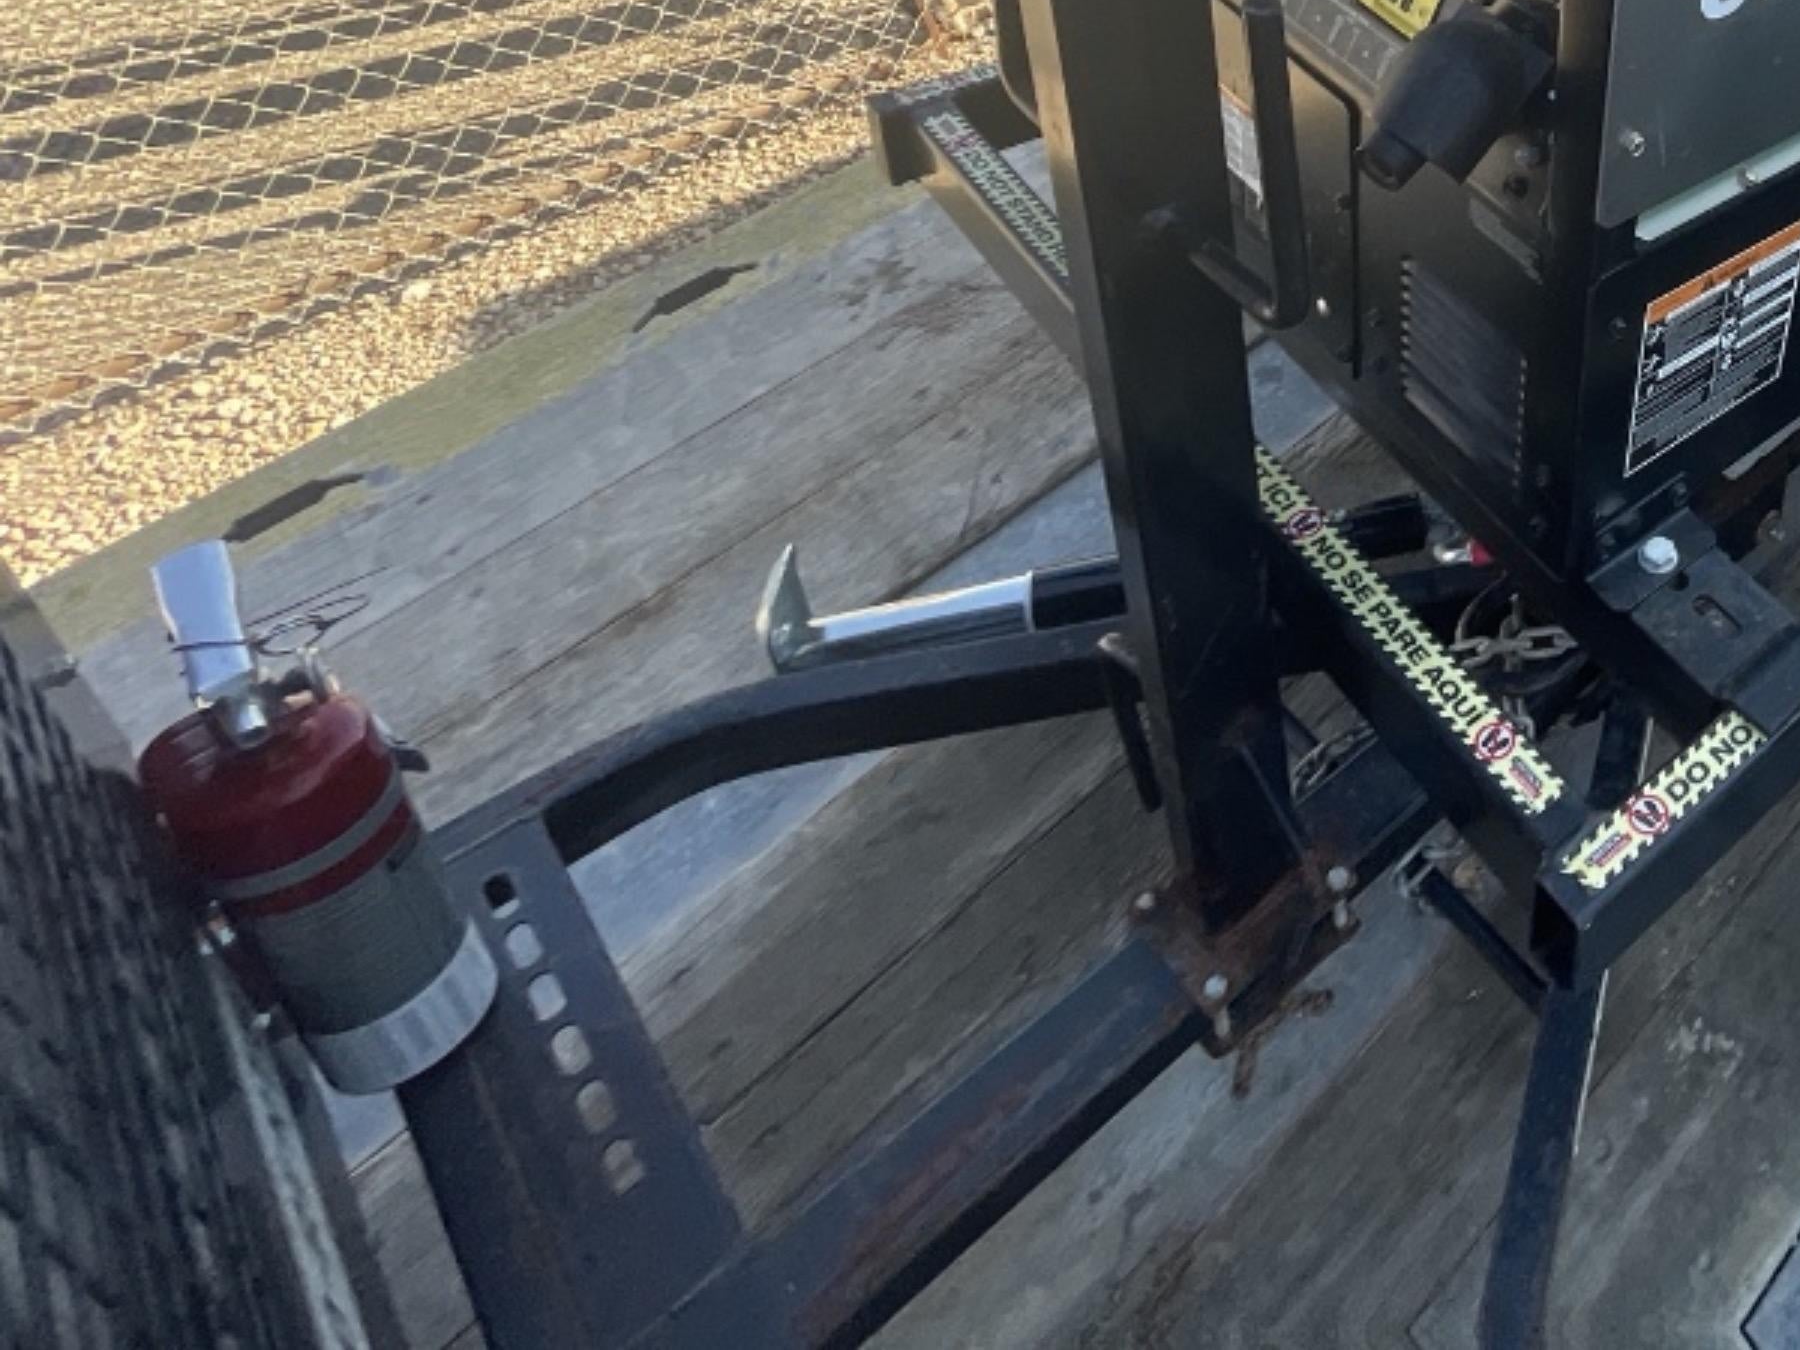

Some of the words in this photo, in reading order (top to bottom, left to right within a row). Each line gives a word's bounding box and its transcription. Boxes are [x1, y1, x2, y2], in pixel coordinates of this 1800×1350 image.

[1263, 482, 1297, 515] ICI
[1310, 535, 1347, 571] NO
[1341, 569, 1376, 604] SE
[1368, 600, 1432, 666] PARE
[1666, 761, 1711, 802] DO
